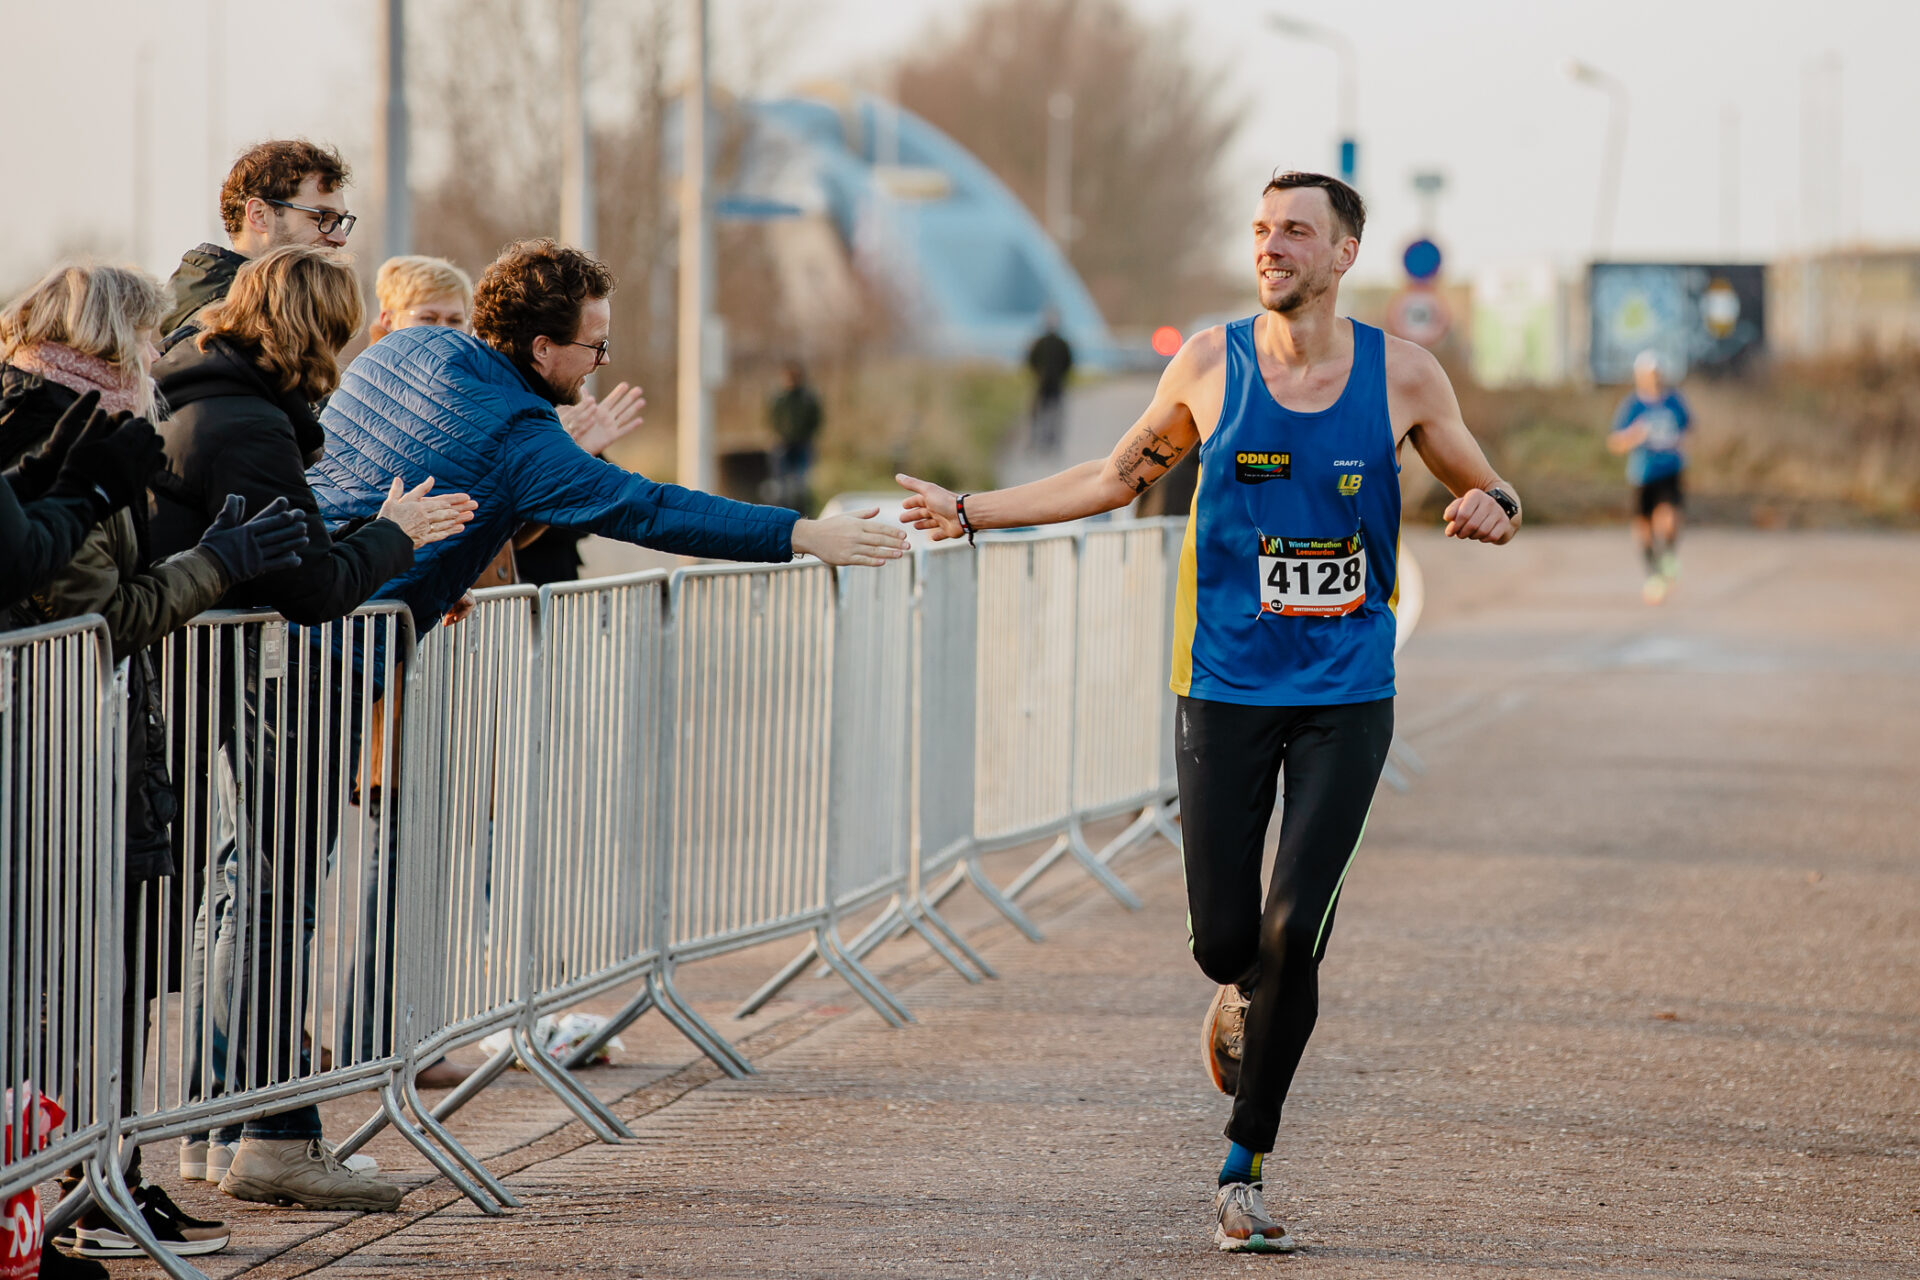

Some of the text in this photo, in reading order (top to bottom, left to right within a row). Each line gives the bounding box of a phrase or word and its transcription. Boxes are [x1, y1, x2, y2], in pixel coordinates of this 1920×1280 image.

[1236, 453, 1290, 465] ODN Oil
[1337, 474, 1363, 489] LB
[1311, 540, 1342, 548] Marathon
[1267, 557, 1361, 595] 4128
